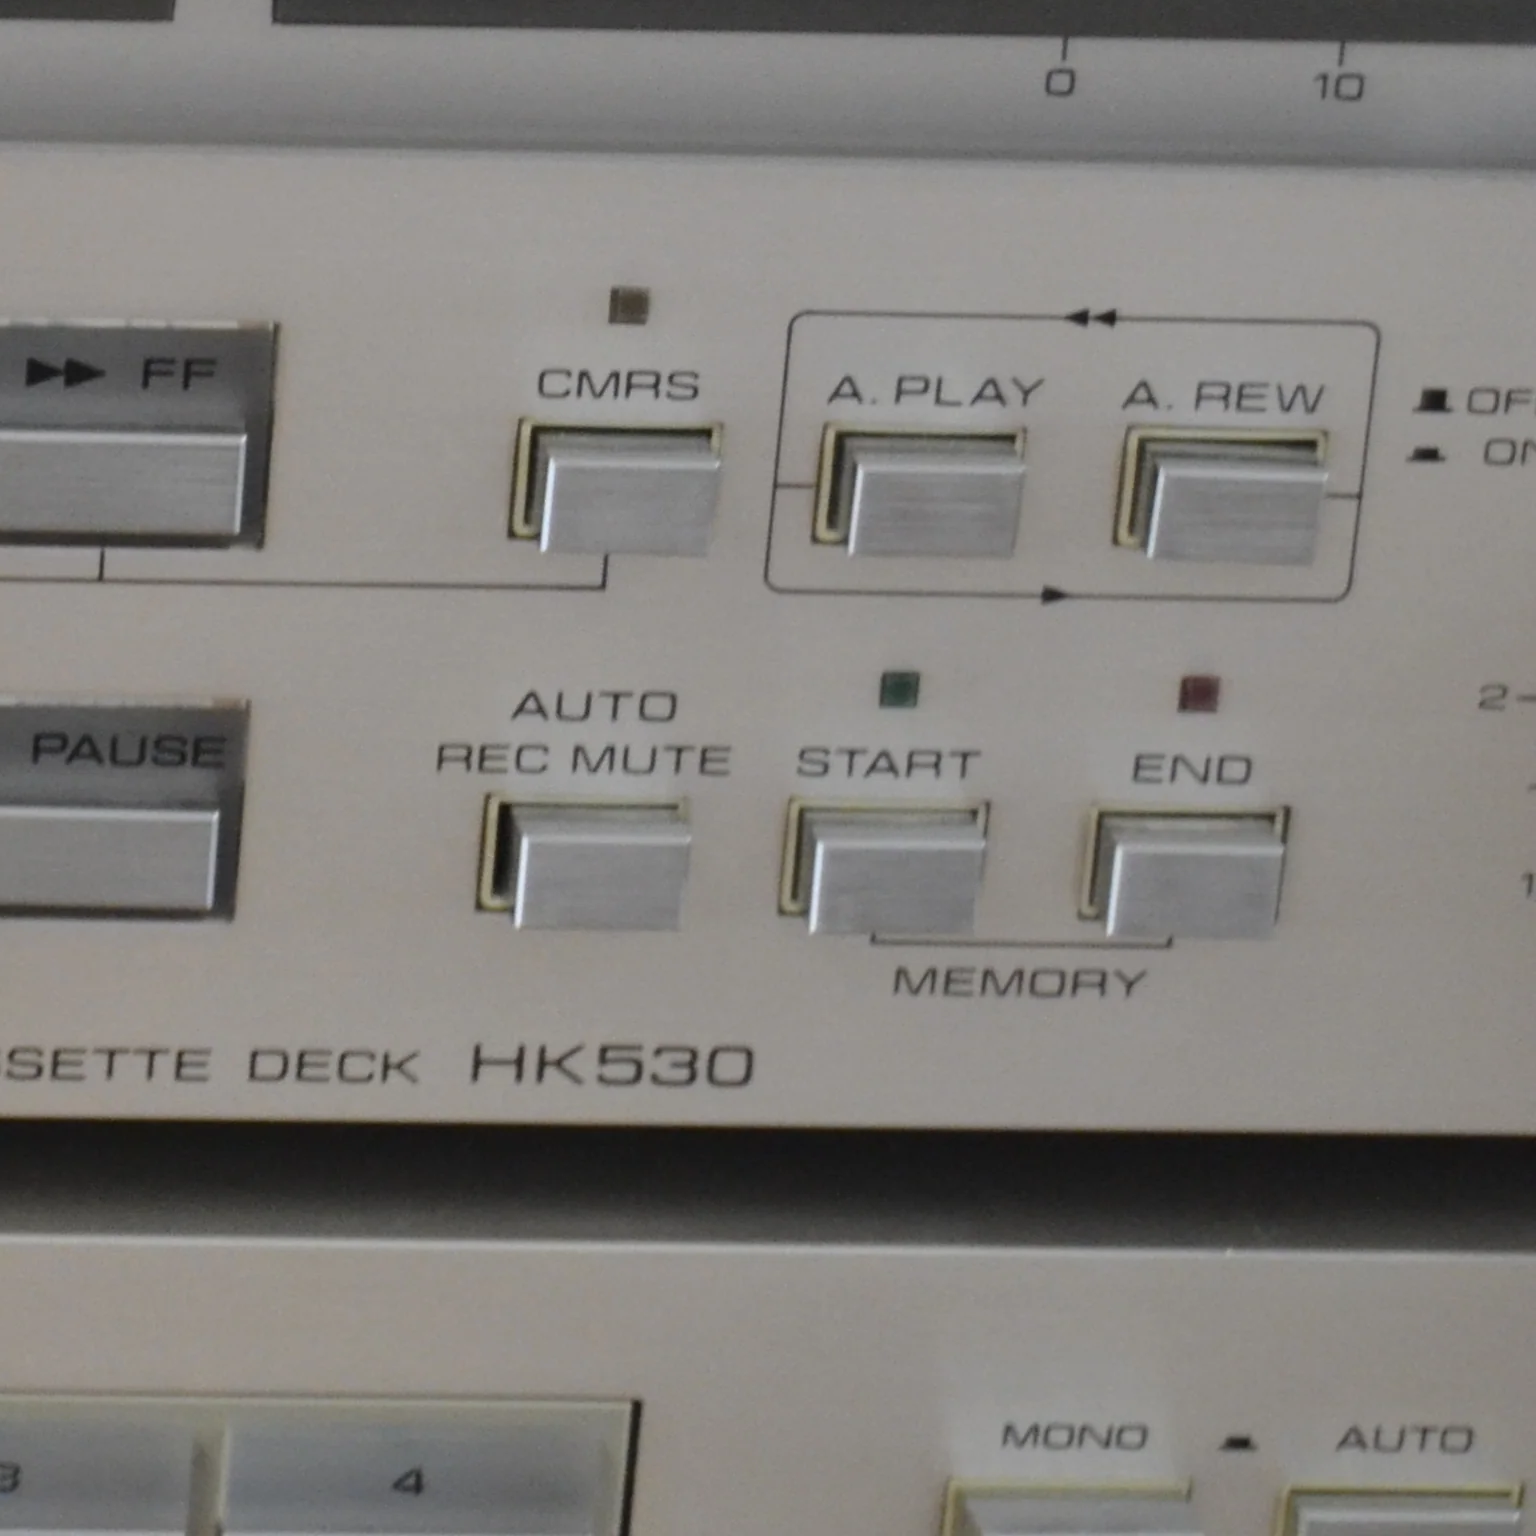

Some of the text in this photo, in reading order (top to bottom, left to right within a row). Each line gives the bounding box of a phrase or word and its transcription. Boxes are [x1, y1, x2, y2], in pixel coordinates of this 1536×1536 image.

[1044, 67, 1077, 98] 0
[1316, 72, 1365, 103] 10
[141, 357, 218, 391] FF
[537, 369, 700, 401] CMRS
[894, 375, 1044, 407] PLAY
[1194, 381, 1325, 415] REW
[1467, 387, 1536, 414] OF
[511, 690, 678, 723] AUTO
[1477, 683, 1510, 712] 2
[32, 732, 229, 769] PAUSE
[436, 743, 731, 776] REC MUTE
[797, 747, 981, 779] START
[1132, 753, 1254, 786] END
[893, 966, 1146, 998] MEMORY
[248, 1049, 417, 1083] DECK
[471, 1043, 755, 1088] HK530
[1001, 1422, 1149, 1451] MONO
[1336, 1425, 1476, 1454] AUTO
[392, 1468, 425, 1496] 4
